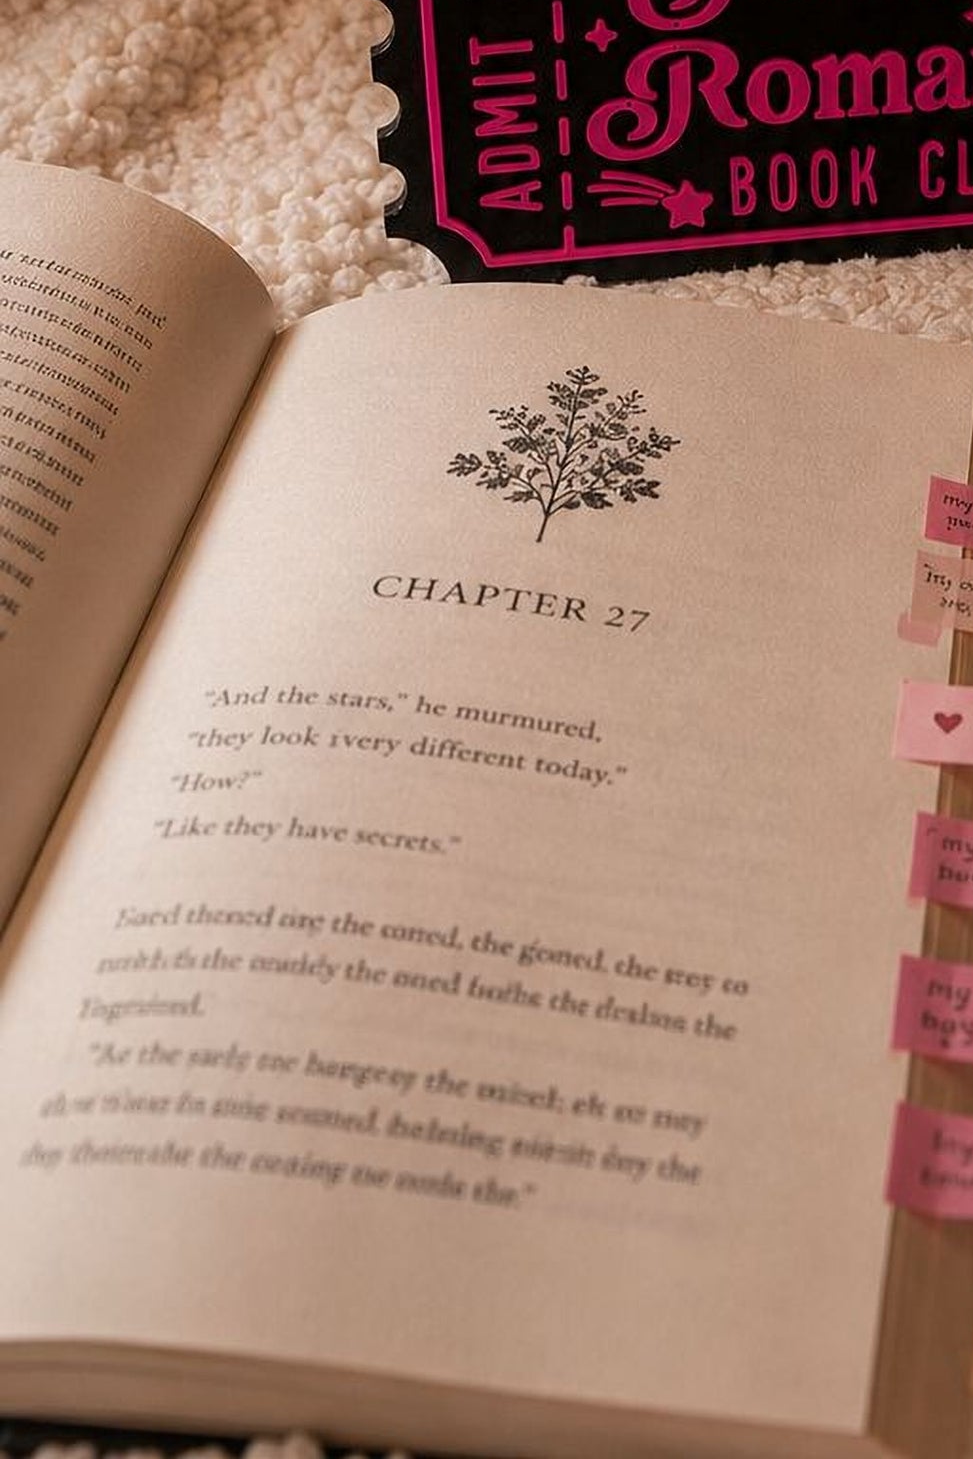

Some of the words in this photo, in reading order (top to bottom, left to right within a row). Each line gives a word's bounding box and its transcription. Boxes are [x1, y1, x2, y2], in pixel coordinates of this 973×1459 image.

[469, 35, 546, 213] ADMIT
[728, 144, 879, 218] BOOK
[372, 575, 587, 622] CHAPTER
[603, 606, 651, 633] 27
[276, 685, 319, 706] the
[415, 695, 447, 717] he
[455, 705, 602, 743] murmured,
[260, 725, 320, 747] look
[409, 736, 526, 770] different
[223, 815, 281, 842] they
[287, 817, 349, 842] have
